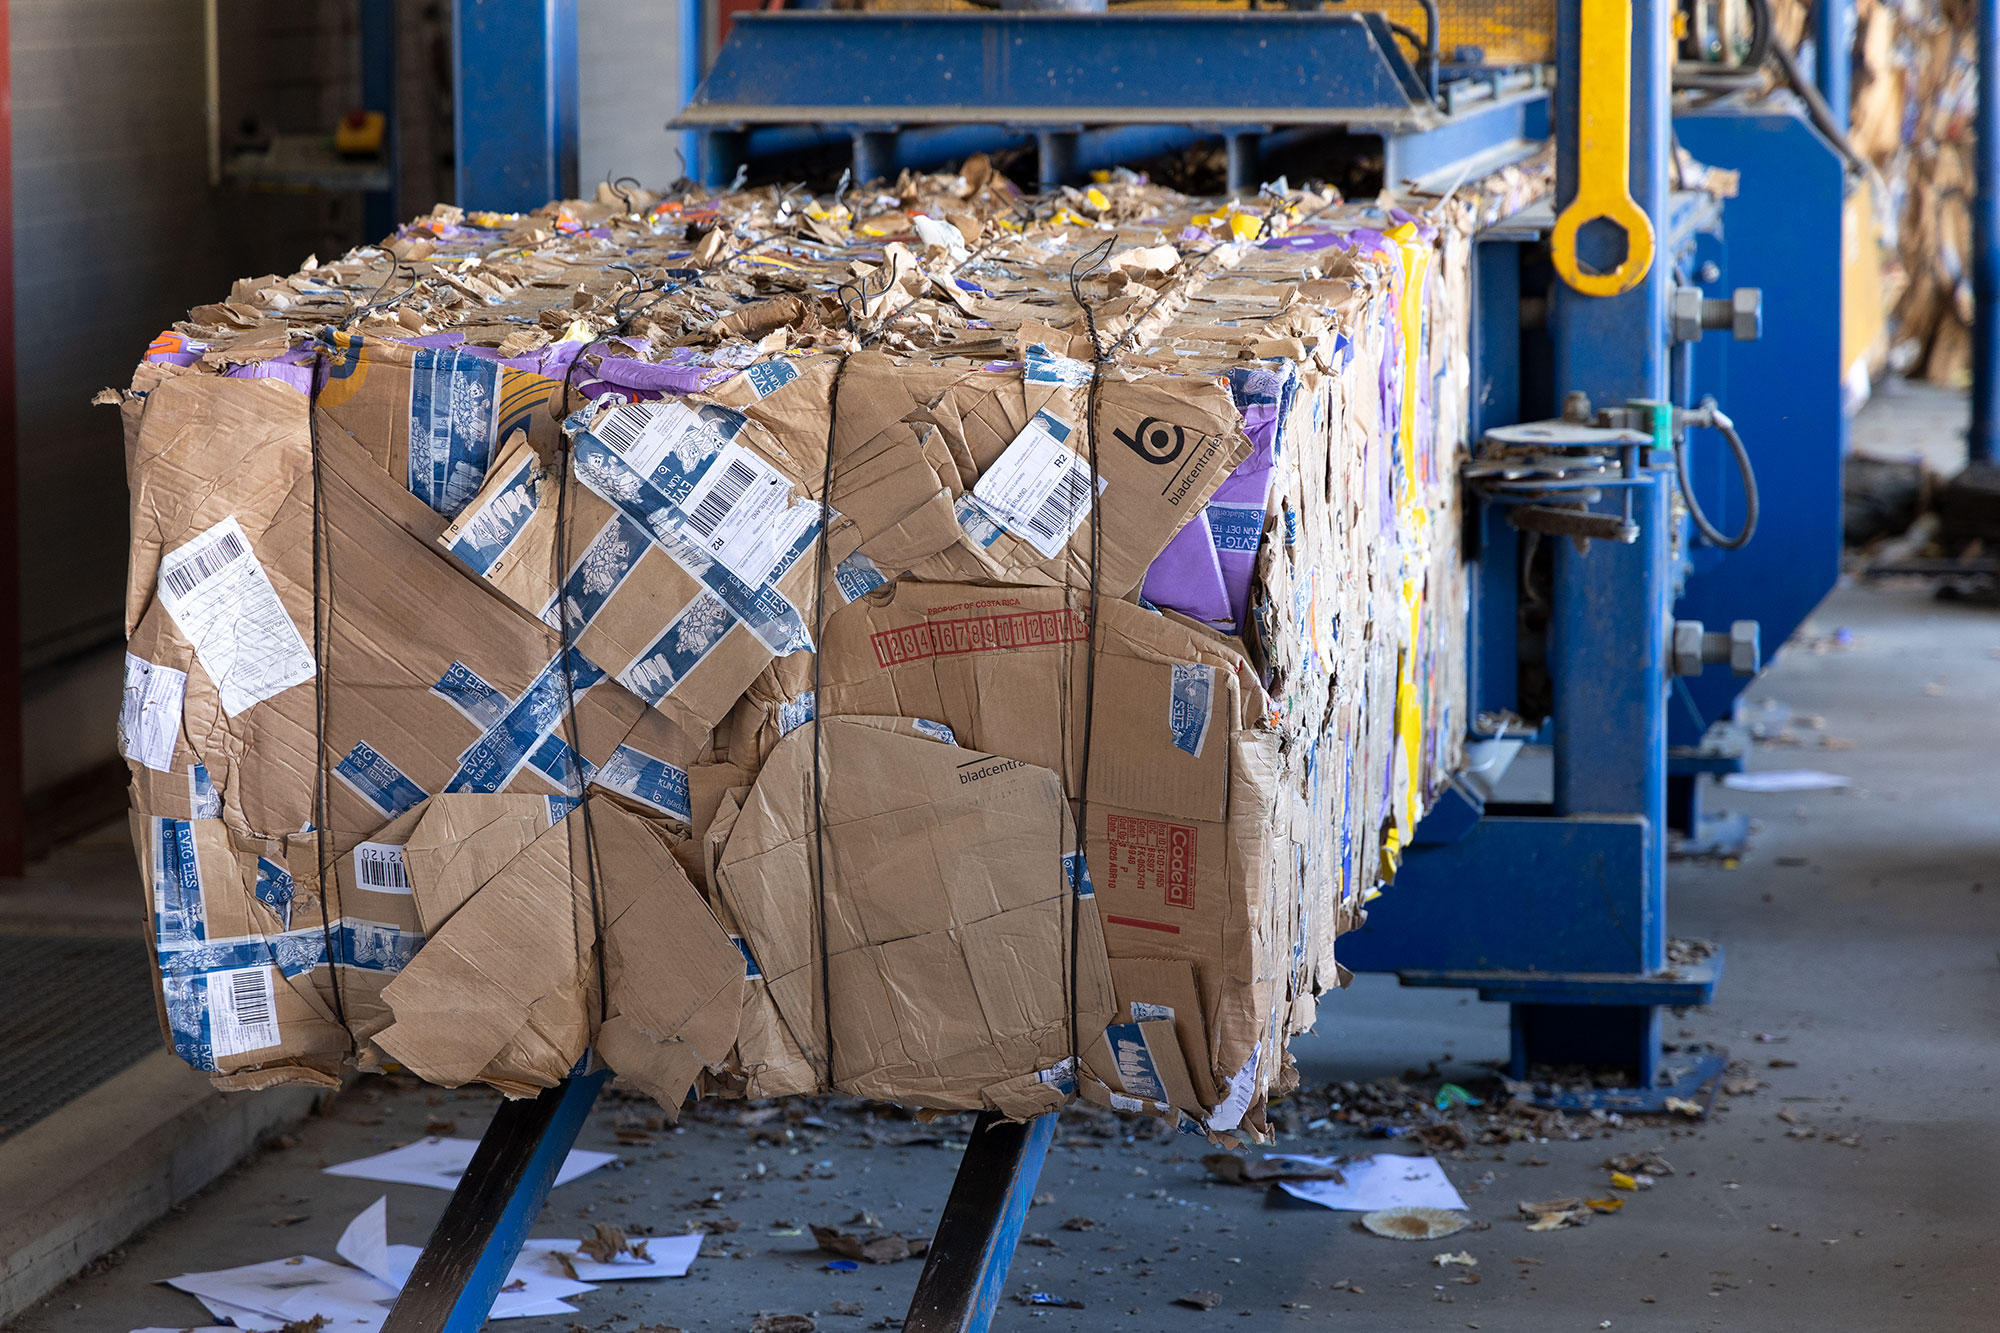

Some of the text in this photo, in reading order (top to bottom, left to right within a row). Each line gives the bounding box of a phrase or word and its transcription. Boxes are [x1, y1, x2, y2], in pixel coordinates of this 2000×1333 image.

[747, 364, 773, 396] EVIG
[768, 372, 782, 389] KUN
[1053, 452, 1067, 468] R2
[666, 472, 682, 489] KUN
[1225, 535, 1257, 549] EVIG
[1226, 525, 1240, 533] DET
[1242, 526, 1259, 534] KUN
[710, 536, 725, 551] R2
[725, 573, 778, 621] KUN DET TEIPTE
[833, 571, 865, 602] EIES
[760, 587, 789, 614] EIES
[927, 603, 963, 615] PRODUCT
[975, 598, 1001, 609] COSTA
[1001, 597, 1020, 607] RICA
[890, 638, 902, 656] 2
[905, 634, 914, 654] 3
[920, 628, 928, 649] 4
[943, 627, 952, 647] 6
[957, 627, 966, 646] 7
[972, 625, 980, 643] 8
[986, 623, 994, 643] 9
[999, 622, 1010, 641] 10
[1013, 620, 1025, 640] 11
[1028, 619, 1040, 638] 12
[1043, 617, 1055, 637] 13
[1058, 615, 1070, 635] 14
[464, 673, 492, 699] EIES
[352, 755, 368, 770] DET
[365, 766, 391, 789] TEIPTE
[371, 756, 400, 782] EIES
[462, 745, 489, 776] EVIG
[472, 766, 487, 783] KUN
[483, 753, 498, 770] DET
[656, 777, 674, 790] KUN
[1129, 819, 1137, 838] Batch
[1138, 821, 1146, 837] Code
[177, 829, 197, 888] EVIG EIES
[1169, 830, 1188, 899] Codela
[199, 1043, 214, 1071] EVIG
